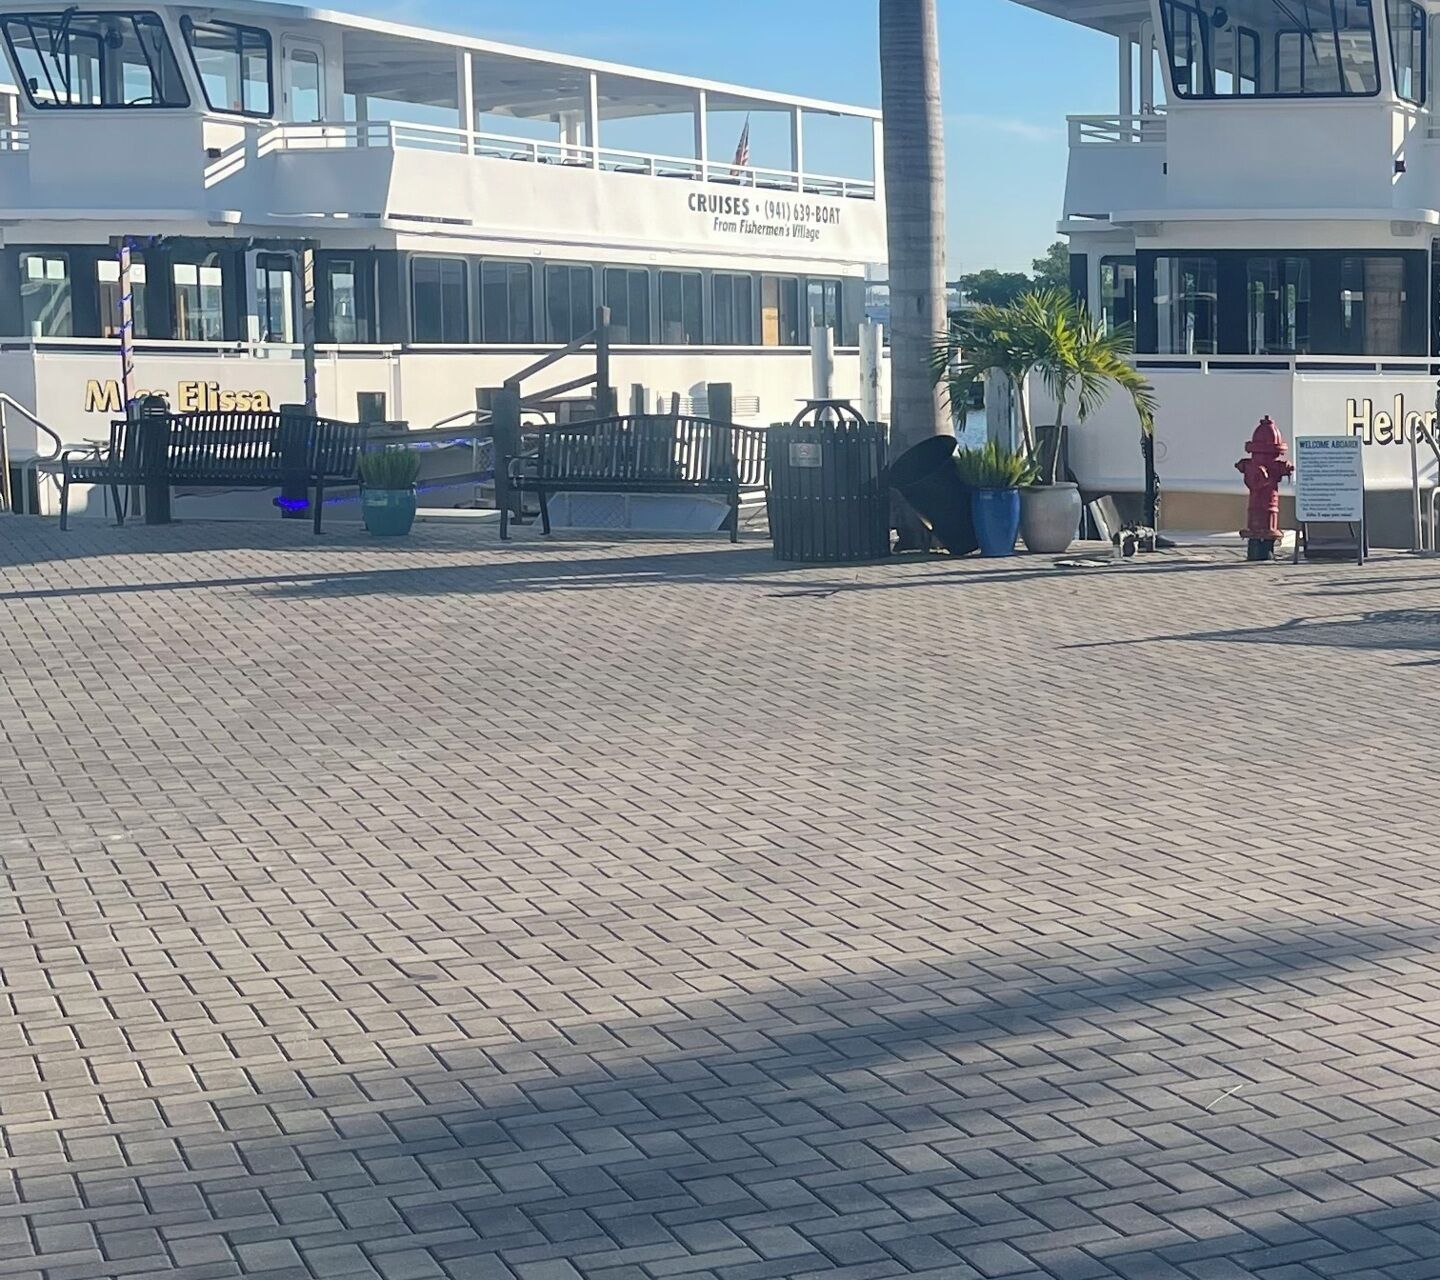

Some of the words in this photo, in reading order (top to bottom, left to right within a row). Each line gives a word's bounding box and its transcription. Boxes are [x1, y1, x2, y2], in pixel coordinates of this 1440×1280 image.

[688, 192, 750, 216] CRUISES
[764, 200, 791, 222] (941)
[793, 202, 841, 225] 639-BOAT
[713, 217, 737, 233] From
[739, 219, 790, 238] Fishermen's
[792, 223, 820, 242] Village
[178, 380, 272, 412] Elissa
[1299, 440, 1330, 449] WELCOME
